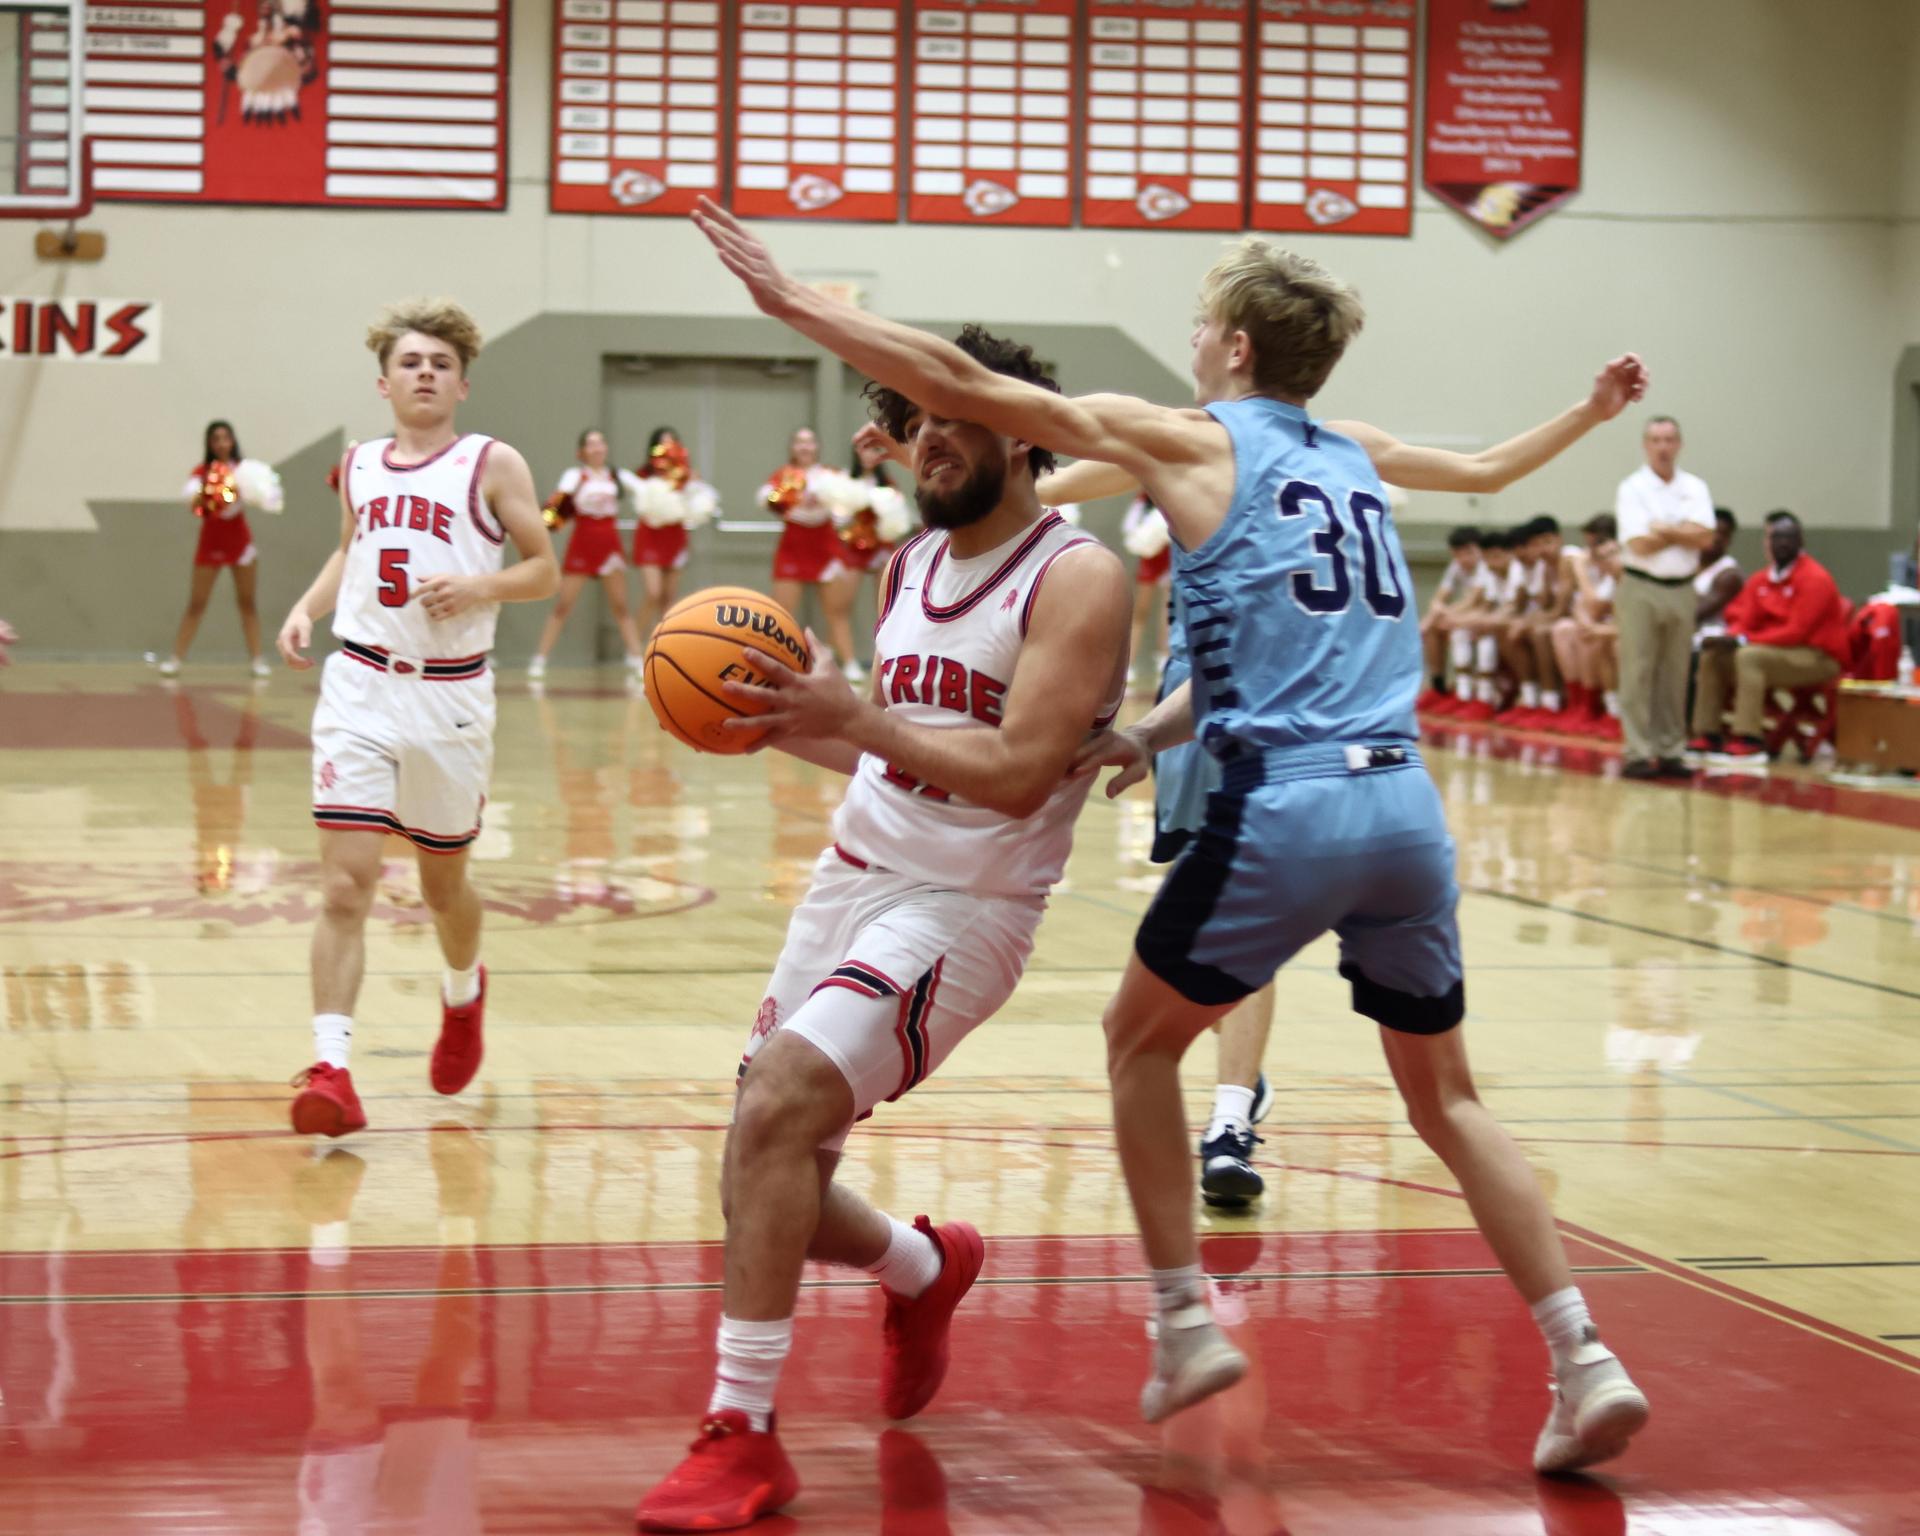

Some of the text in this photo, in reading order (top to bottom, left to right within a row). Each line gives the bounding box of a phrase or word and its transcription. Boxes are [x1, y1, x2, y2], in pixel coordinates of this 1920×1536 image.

[0, 302, 152, 355] INS
[377, 548, 410, 608] 5
[1273, 479, 1407, 623] 30
[715, 604, 807, 671] Wilson
